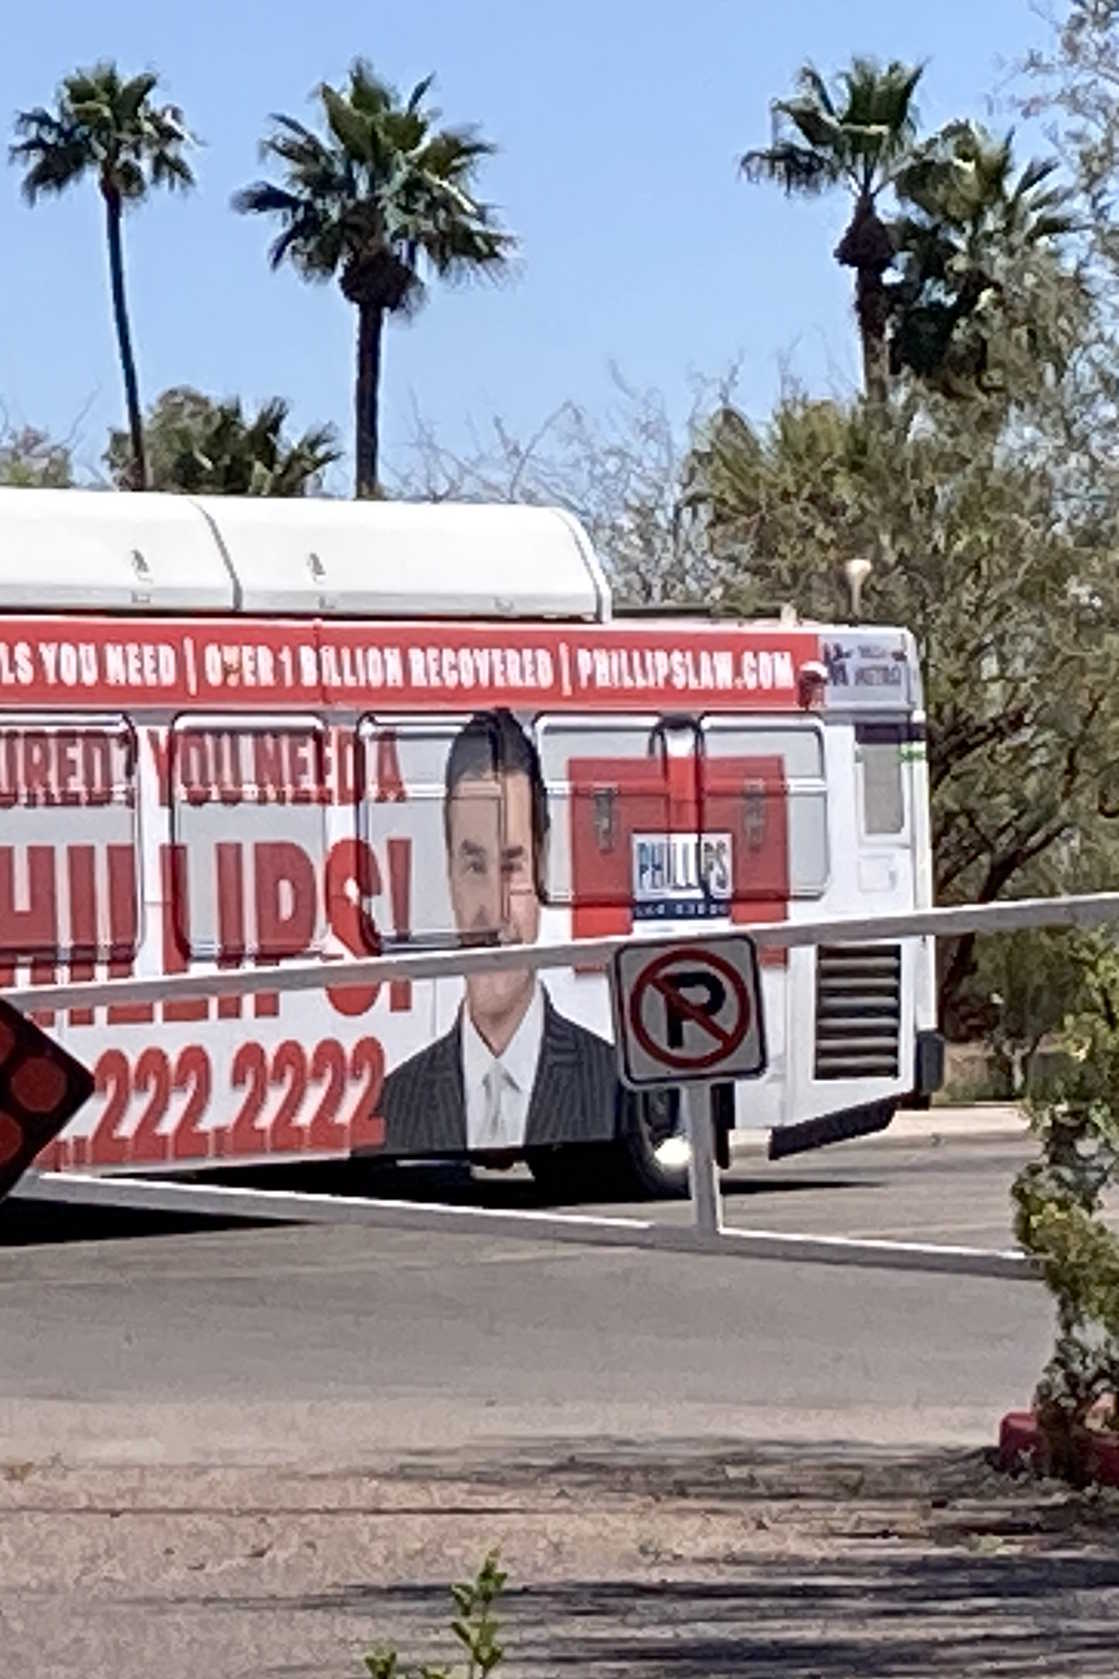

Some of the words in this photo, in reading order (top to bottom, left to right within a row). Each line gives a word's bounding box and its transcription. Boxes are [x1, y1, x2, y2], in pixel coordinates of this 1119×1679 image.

[38, 642, 98, 687] YOU
[104, 643, 176, 688] NEED
[204, 643, 276, 688] OVER
[278, 645, 293, 688] 1
[300, 645, 404, 688] BILLION
[408, 647, 554, 689] RECOVERED
[577, 648, 795, 690] PHILLIPSLAW.COM
[147, 729, 244, 806] YOU
[254, 729, 362, 806] NEED
[374, 731, 408, 803] A
[32, 1035, 386, 1172] .222.2222
